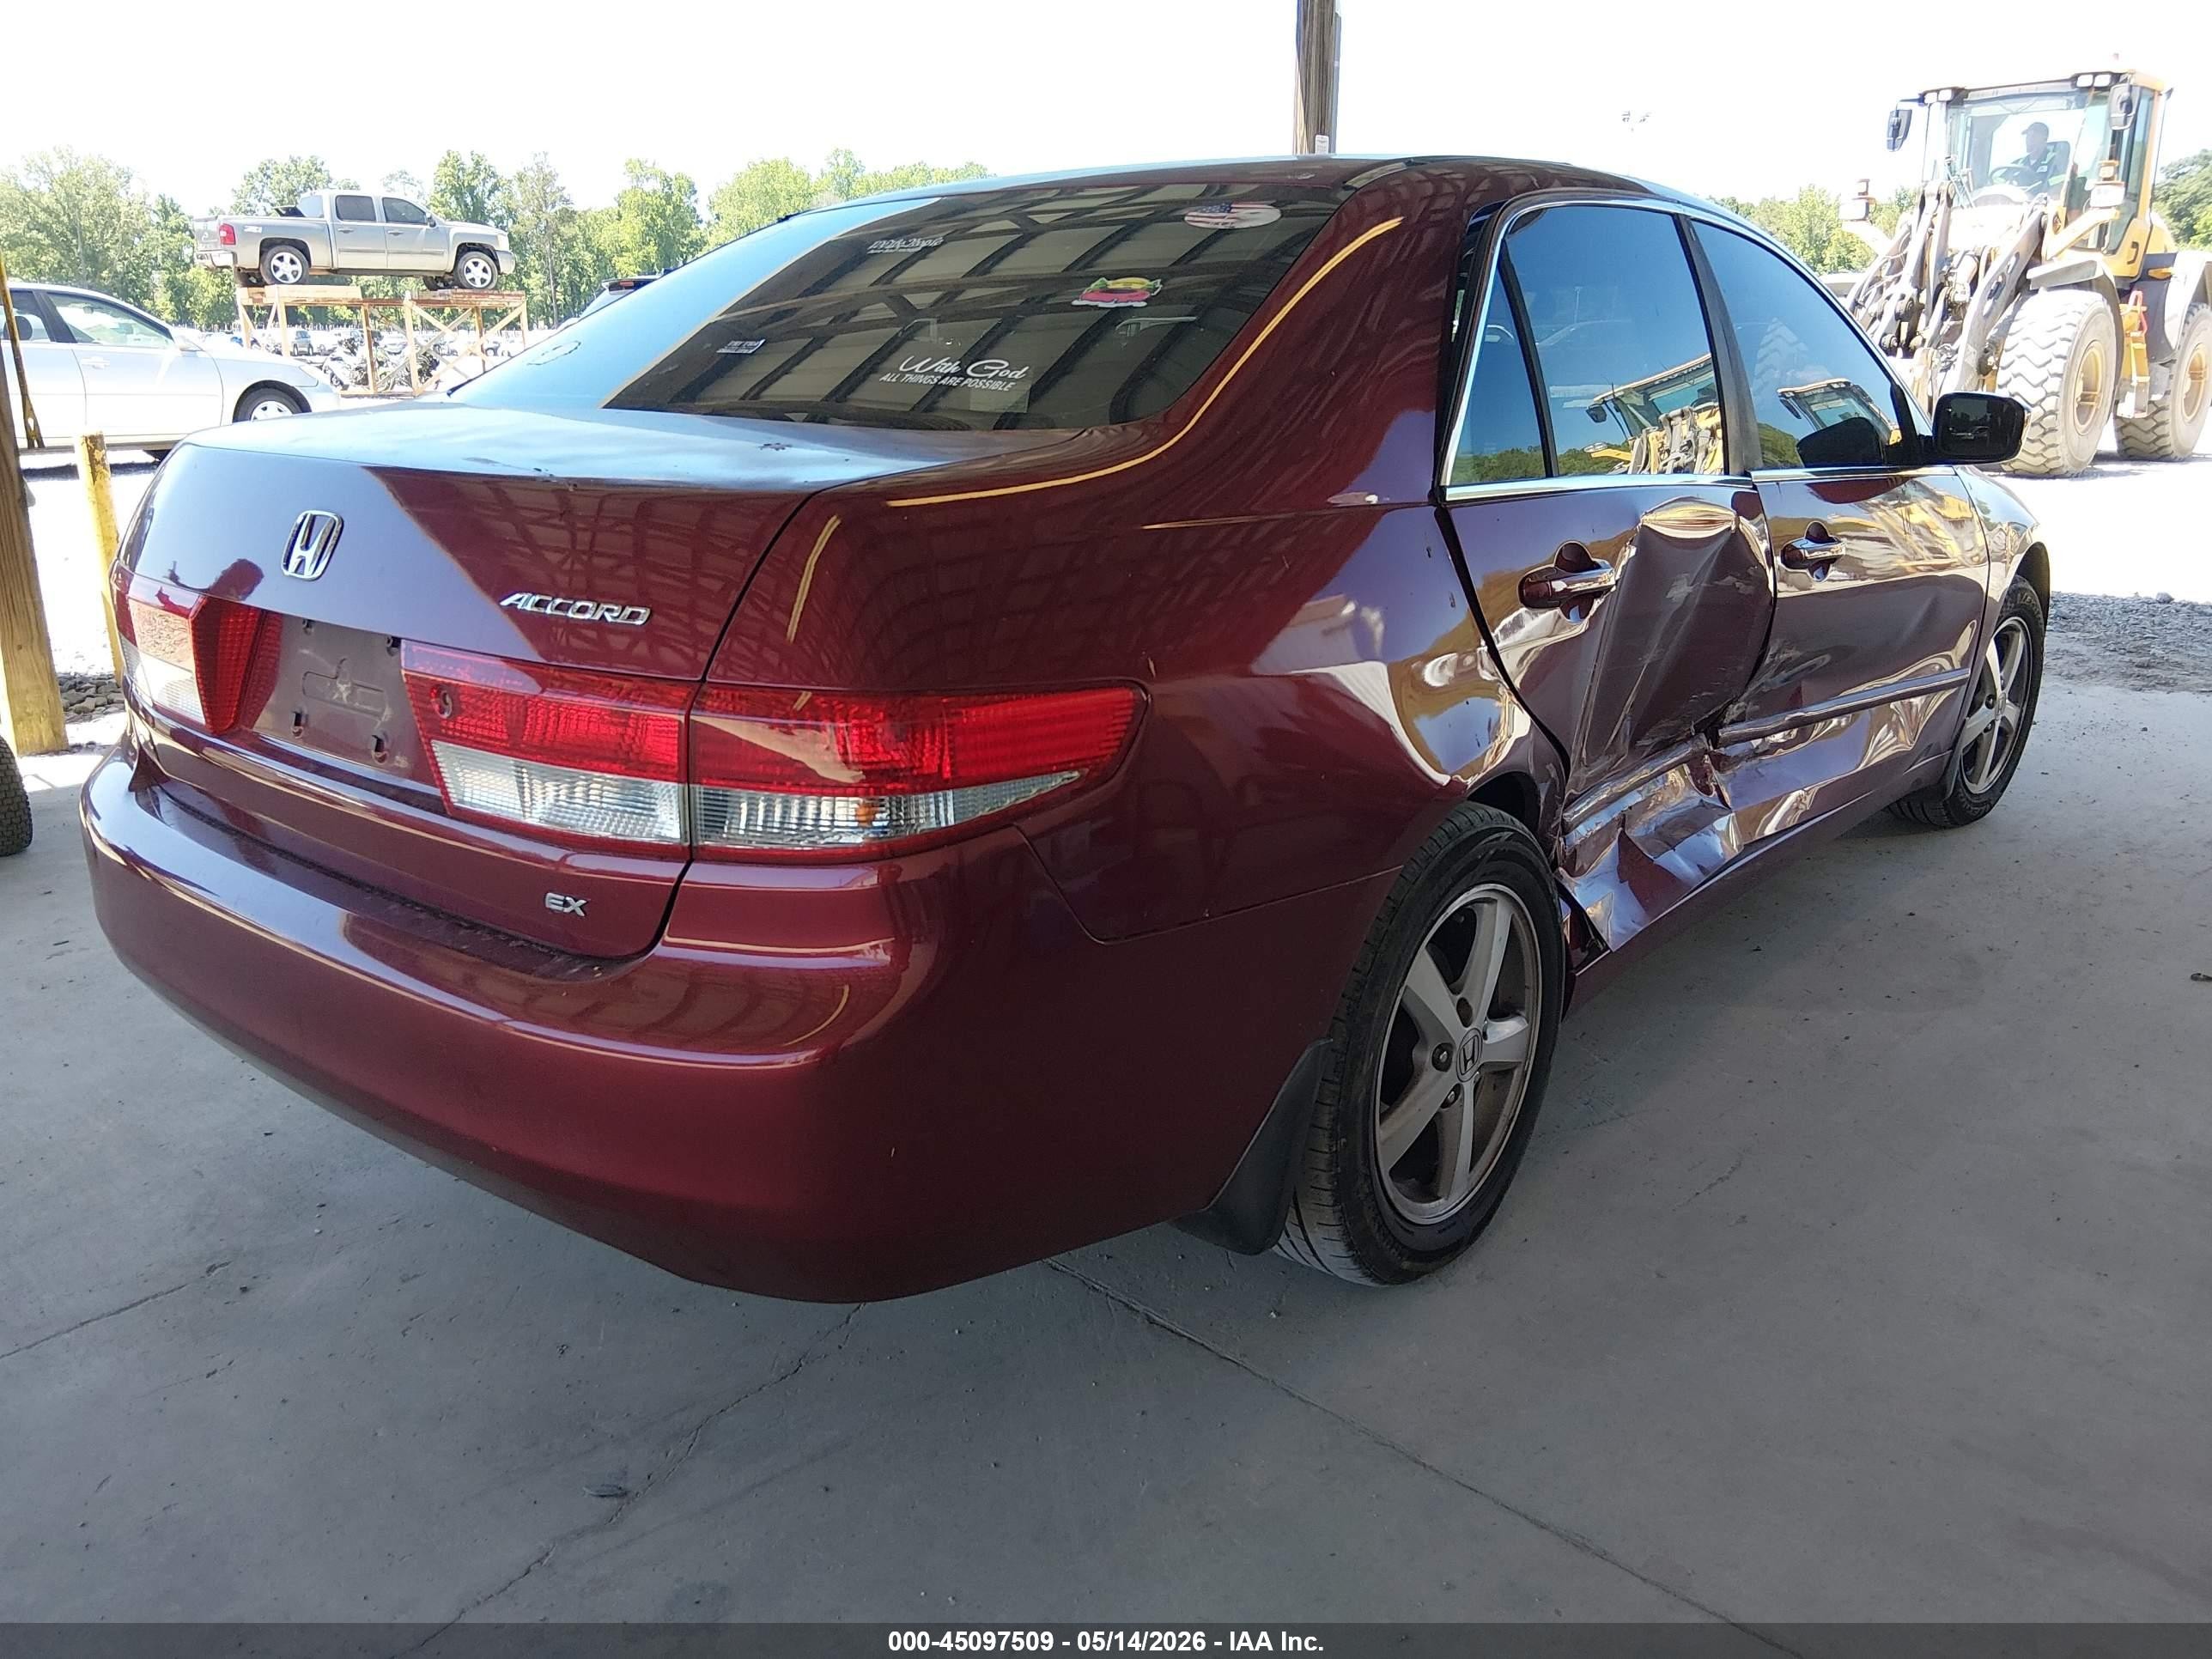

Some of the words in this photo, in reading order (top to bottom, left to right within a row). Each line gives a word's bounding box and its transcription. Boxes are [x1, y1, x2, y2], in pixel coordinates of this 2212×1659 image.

[899, 356, 962, 374] With
[966, 359, 1030, 380] God
[878, 373, 901, 383] ALL
[901, 374, 941, 386] THINGS
[938, 376, 964, 387] ARE
[960, 377, 1017, 392] POSSIBLE
[500, 592, 650, 625] ACCORD
[545, 893, 587, 917] EX
